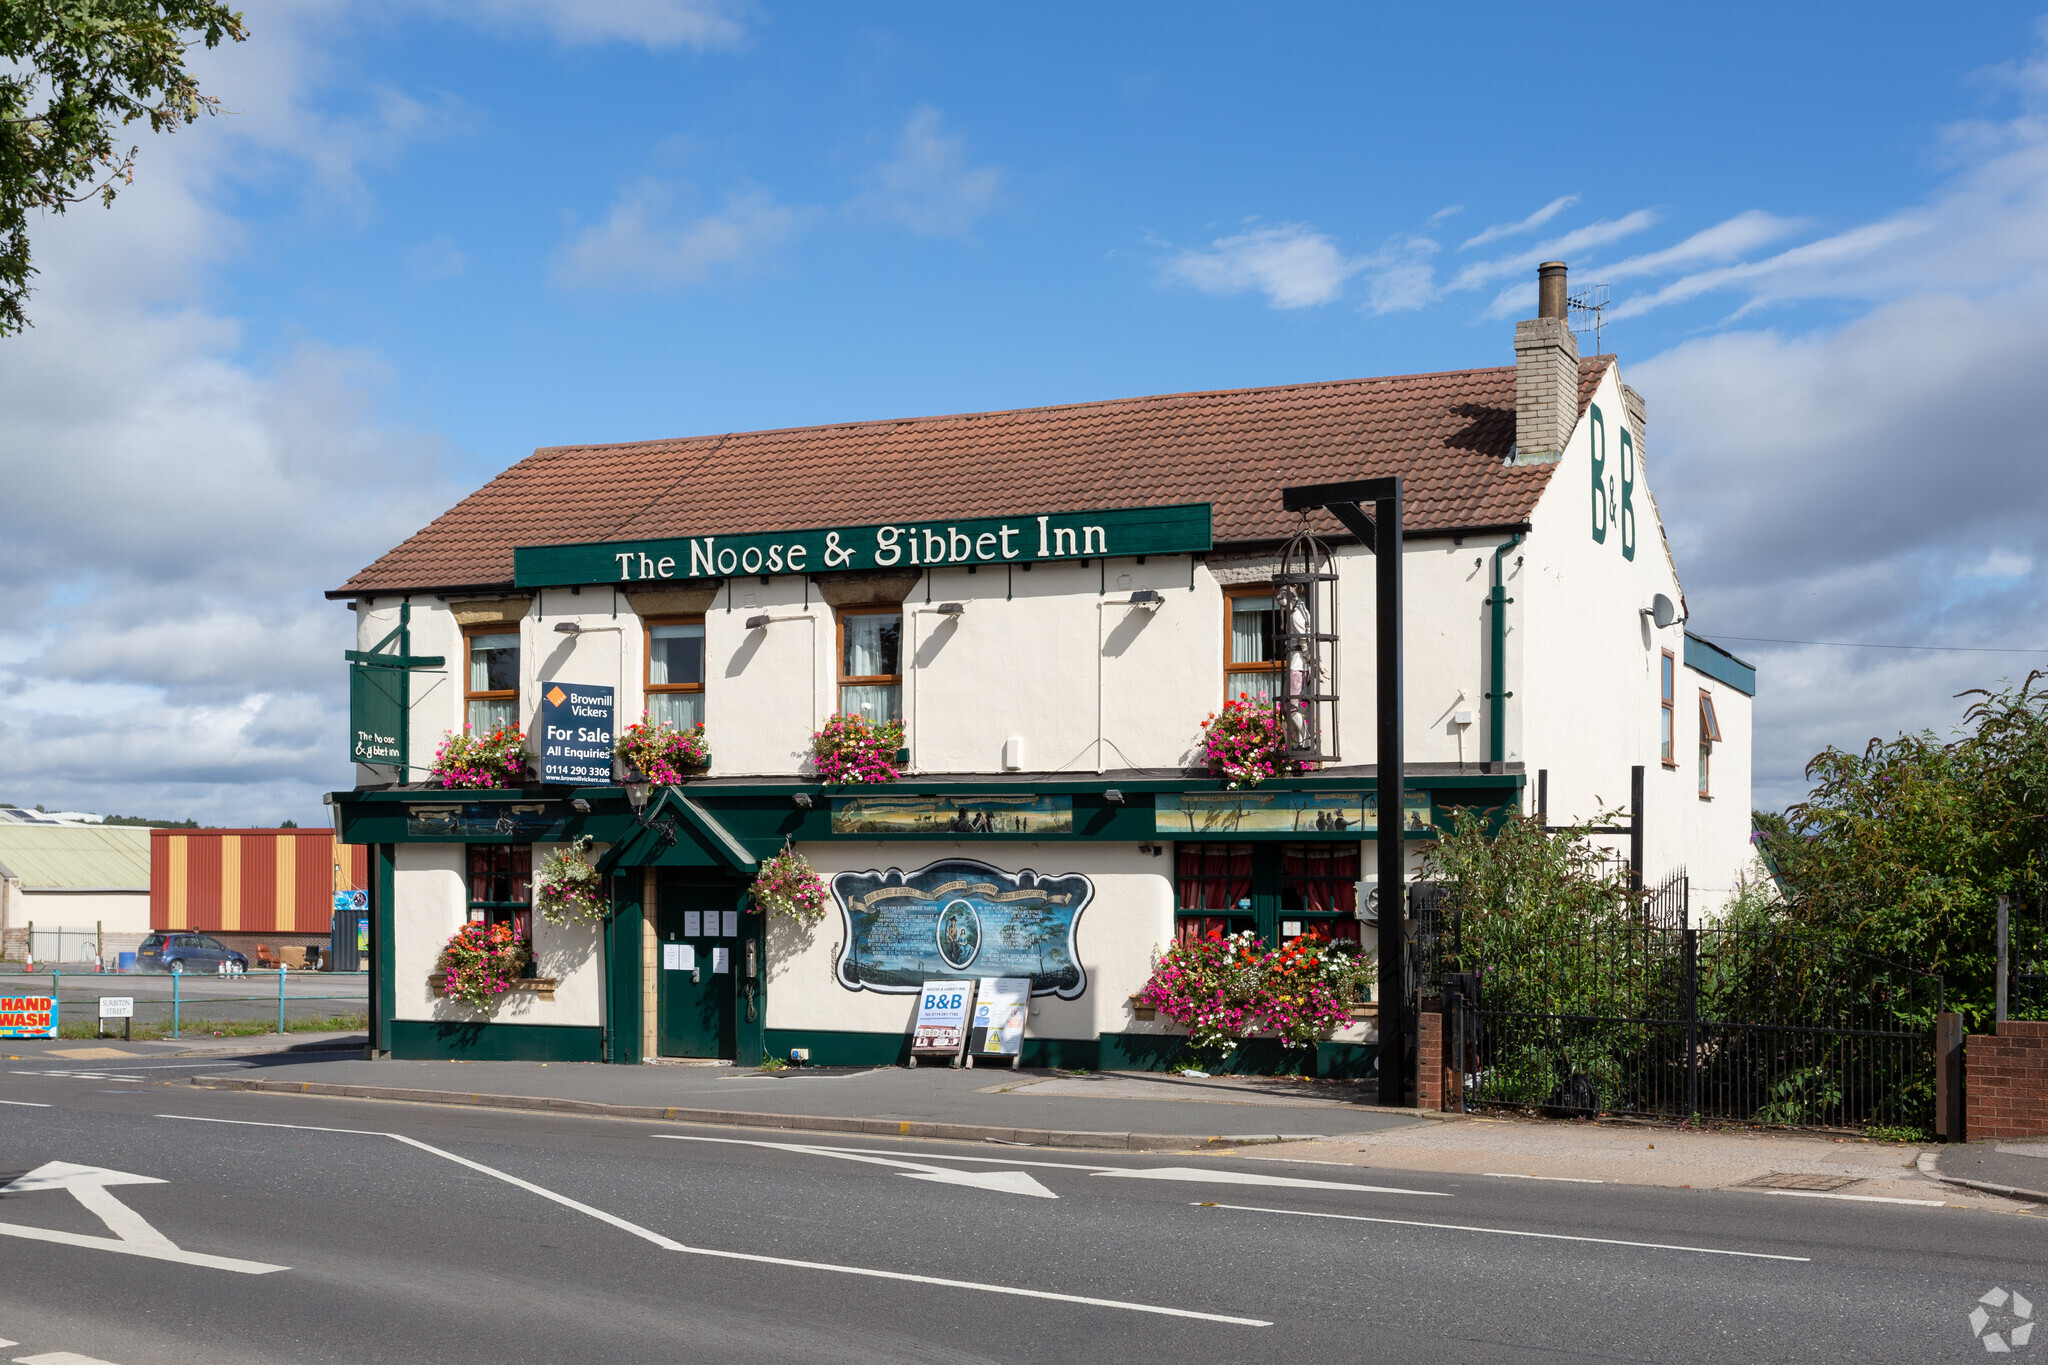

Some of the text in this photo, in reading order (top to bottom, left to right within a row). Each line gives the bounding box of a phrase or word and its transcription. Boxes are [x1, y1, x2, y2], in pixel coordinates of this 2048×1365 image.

[1590, 402, 1636, 563] B&B
[615, 552, 676, 581] The
[689, 537, 807, 577] Noose
[823, 531, 857, 568] &
[1036, 516, 1108, 557] Inn
[570, 693, 612, 706] Brownill
[571, 705, 608, 718] Vickers
[357, 730, 373, 741] The
[547, 725, 610, 743] For Sale
[355, 741, 367, 755] &
[546, 746, 610, 760] All Enquiries
[545, 764, 610, 777] 0114 290 3306
[545, 774, 611, 784] www.brownillvickers.com
[1, 998, 52, 1011] HAND
[925, 994, 962, 1009] B&B
[105, 1007, 126, 1015] STREET
[0, 1013, 51, 1026] WASH
